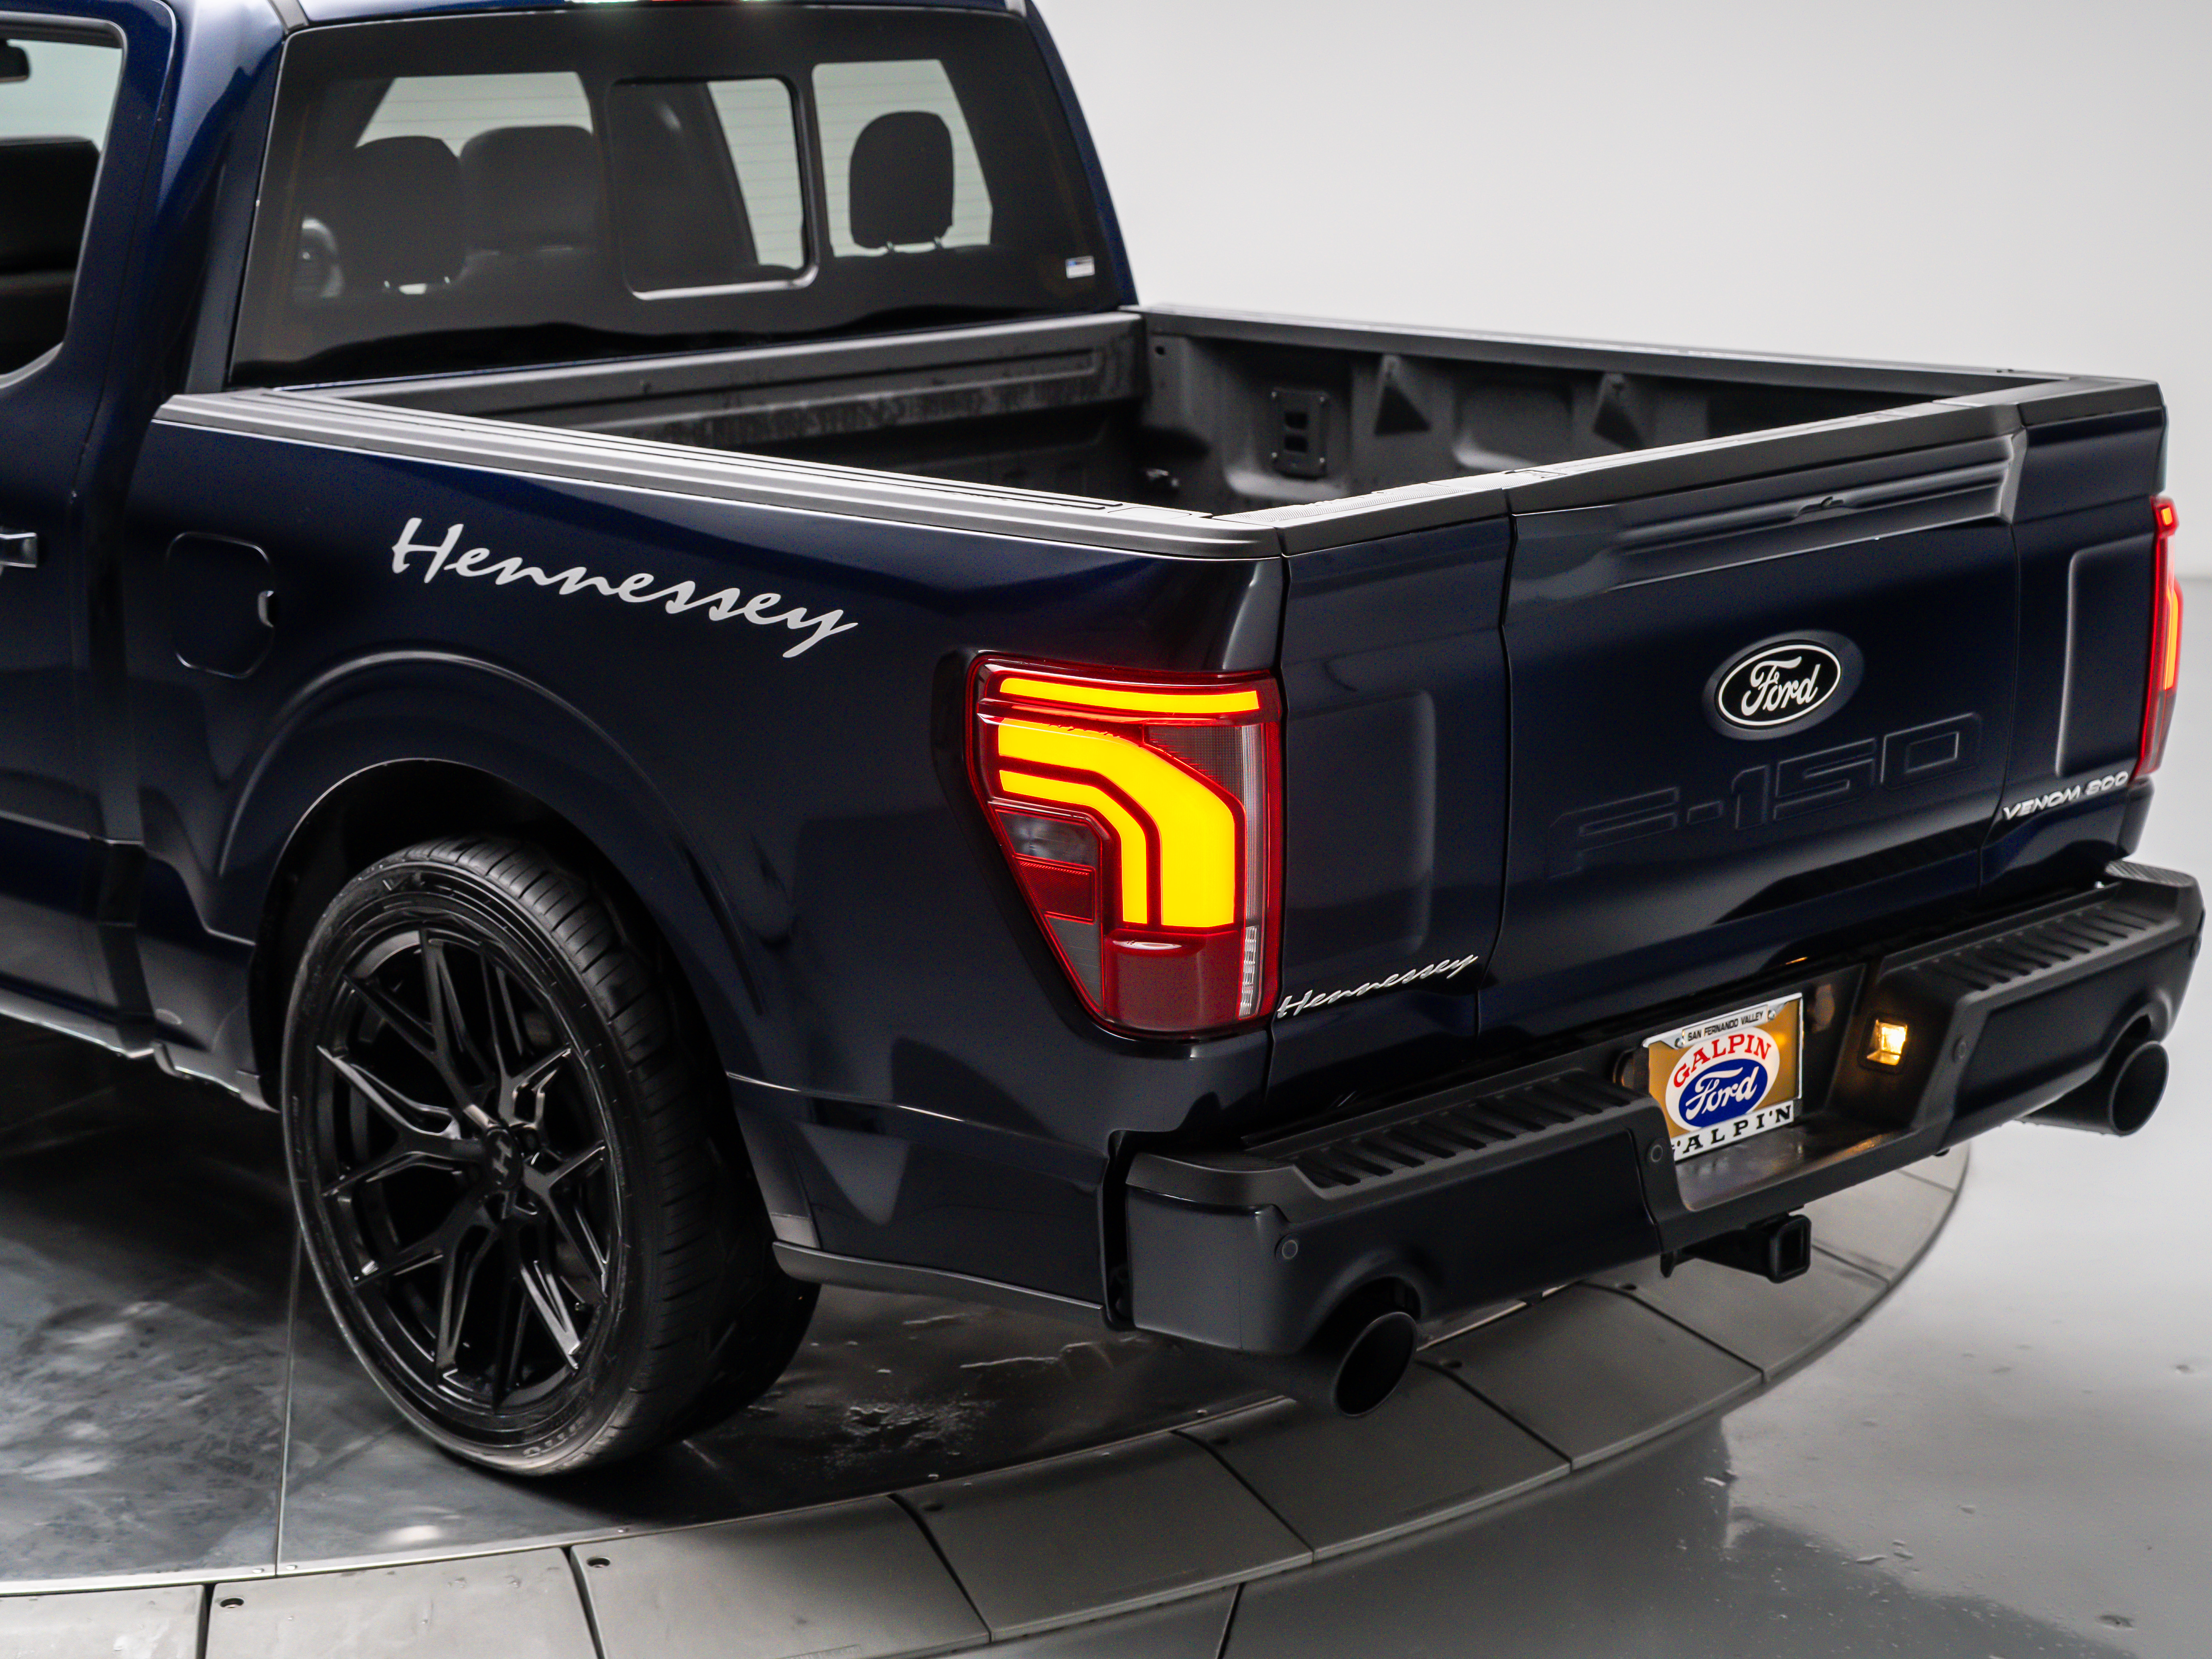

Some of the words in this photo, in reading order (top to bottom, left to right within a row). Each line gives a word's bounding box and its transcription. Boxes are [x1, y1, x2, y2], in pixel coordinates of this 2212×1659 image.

[392, 517, 859, 658] Hennessey
[1741, 656, 1820, 716] Ford
[1545, 711, 1980, 878] F-150
[2003, 785, 2081, 820] VENOM
[2086, 771, 2129, 795] 800
[1277, 954, 1478, 1019] Hennessey
[1688, 1031, 1702, 1041] SAN
[1704, 1019, 1738, 1036] FERNANDO
[1741, 1011, 1763, 1025] VALLEY
[1674, 1033, 1771, 1088] GALPIN
[1686, 1066, 1759, 1120] Ford
[1671, 1105, 1791, 1153] 'ALPI'N
